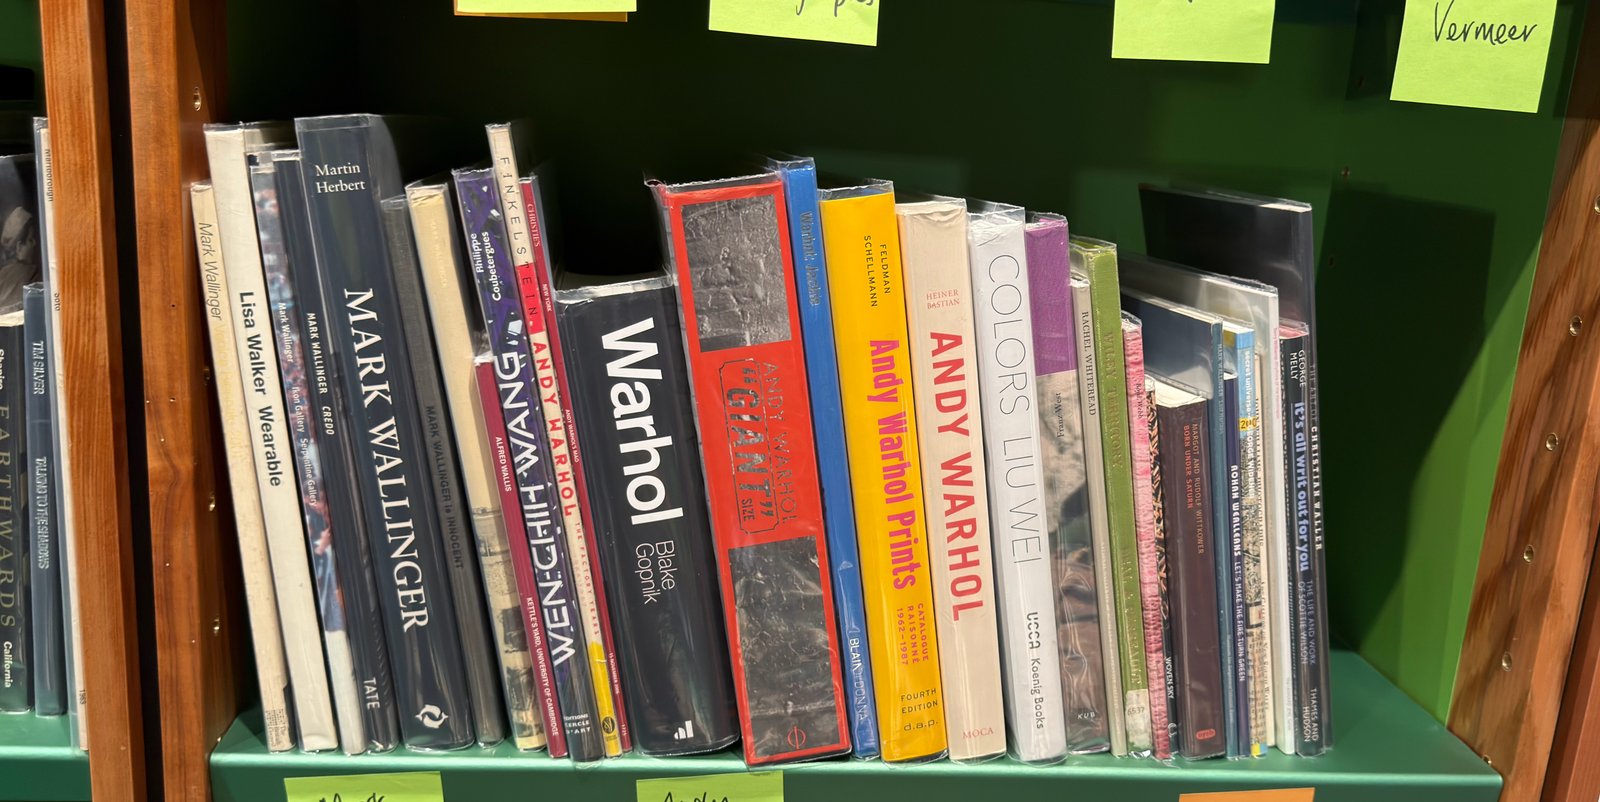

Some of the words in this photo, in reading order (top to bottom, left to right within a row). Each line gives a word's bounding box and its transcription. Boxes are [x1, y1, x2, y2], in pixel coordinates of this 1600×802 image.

[1434, 2, 1537, 46] Vermeer
[315, 162, 361, 177] Martin
[316, 180, 366, 193] Herbert
[199, 222, 213, 256] Mark
[470, 233, 484, 273] Philippe
[500, 157, 538, 315] FINKELSTEIN
[481, 231, 501, 301] Coubetergues
[863, 235, 878, 308] SCHELLMANN
[879, 244, 891, 294] FELDMAN
[204, 261, 222, 320] Wallinger
[926, 289, 959, 300] HEINER
[927, 298, 961, 310] BASTIAN
[278, 302, 288, 323] Mark
[307, 313, 319, 339] MARK
[1081, 311, 1092, 351] RACHEL
[32, 340, 44, 359] TIM
[281, 325, 294, 362] Wallinger
[989, 255, 1030, 414] COLORS
[33, 360, 45, 395] SILVER
[312, 342, 328, 394] WALLINGER
[867, 340, 904, 403] Andy
[930, 332, 970, 436] ANDY
[1085, 354, 1096, 416] WHITEREAD
[1290, 353, 1298, 380] MELLY
[1298, 350, 1306, 387] GEORGE
[239, 292, 255, 328] Lisa
[247, 334, 266, 395] Walker
[258, 405, 283, 486] Wearable
[292, 386, 300, 404] Ikon
[762, 362, 785, 421] ANDY
[295, 404, 305, 433] Gallery
[322, 406, 335, 435] CREDO
[426, 406, 440, 436] MARK
[493, 352, 539, 475] WANG
[601, 317, 684, 525] Warhol
[1295, 402, 1305, 430] It's
[495, 437, 507, 464] ALFRED
[567, 423, 577, 450] WARHOL'S
[1295, 433, 1306, 453] all
[300, 438, 313, 478] Serpentine
[344, 288, 392, 408] MARK
[368, 416, 429, 632] WALLINGER
[432, 441, 451, 499] WALLINGER
[878, 411, 914, 505] Warhol
[1003, 436, 1036, 488] LIU
[1295, 455, 1306, 489] writ
[1311, 426, 1320, 496] CHRISTIAN
[305, 479, 317, 506] Gallery
[500, 464, 512, 492] WALLIS
[533, 342, 558, 405] ANDY
[548, 418, 577, 516] WARHOL
[580, 546, 592, 594] FACTORY
[590, 601, 600, 635] YEARS
[773, 432, 798, 524] WARHOL
[1186, 476, 1194, 509] SATURN
[0, 404, 15, 627] EARTHWARDS
[741, 498, 755, 522] SIZE
[1298, 491, 1306, 517] out
[446, 517, 464, 569] INNOCENT
[940, 452, 984, 621] WARHOL
[1009, 498, 1042, 563] WEI
[1196, 509, 1204, 554] WITTKOWER
[1298, 519, 1309, 542] for
[1313, 501, 1322, 550] WALLER
[656, 540, 677, 591] Blake
[887, 510, 921, 590] Prints
[1296, 543, 1309, 571] you
[635, 543, 659, 605] Gopnik
[526, 597, 537, 627] KETTLE'S
[917, 603, 929, 662] CATALOGUE
[3, 641, 13, 688] California
[536, 647, 549, 687] UNIVERSITY
[1031, 658, 1041, 695] Koenig
[1165, 656, 1173, 684] WOVEN
[363, 677, 380, 710] TATE
[543, 687, 551, 696] OF
[901, 688, 937, 702] FOURTH
[901, 700, 938, 714] EDITION
[546, 696, 559, 736] CAMBRIDGE
[904, 719, 938, 731] d.a.p.
[1035, 697, 1044, 729] Books
[1303, 706, 1311, 742] HUDSON
[962, 727, 994, 740] MOCA
